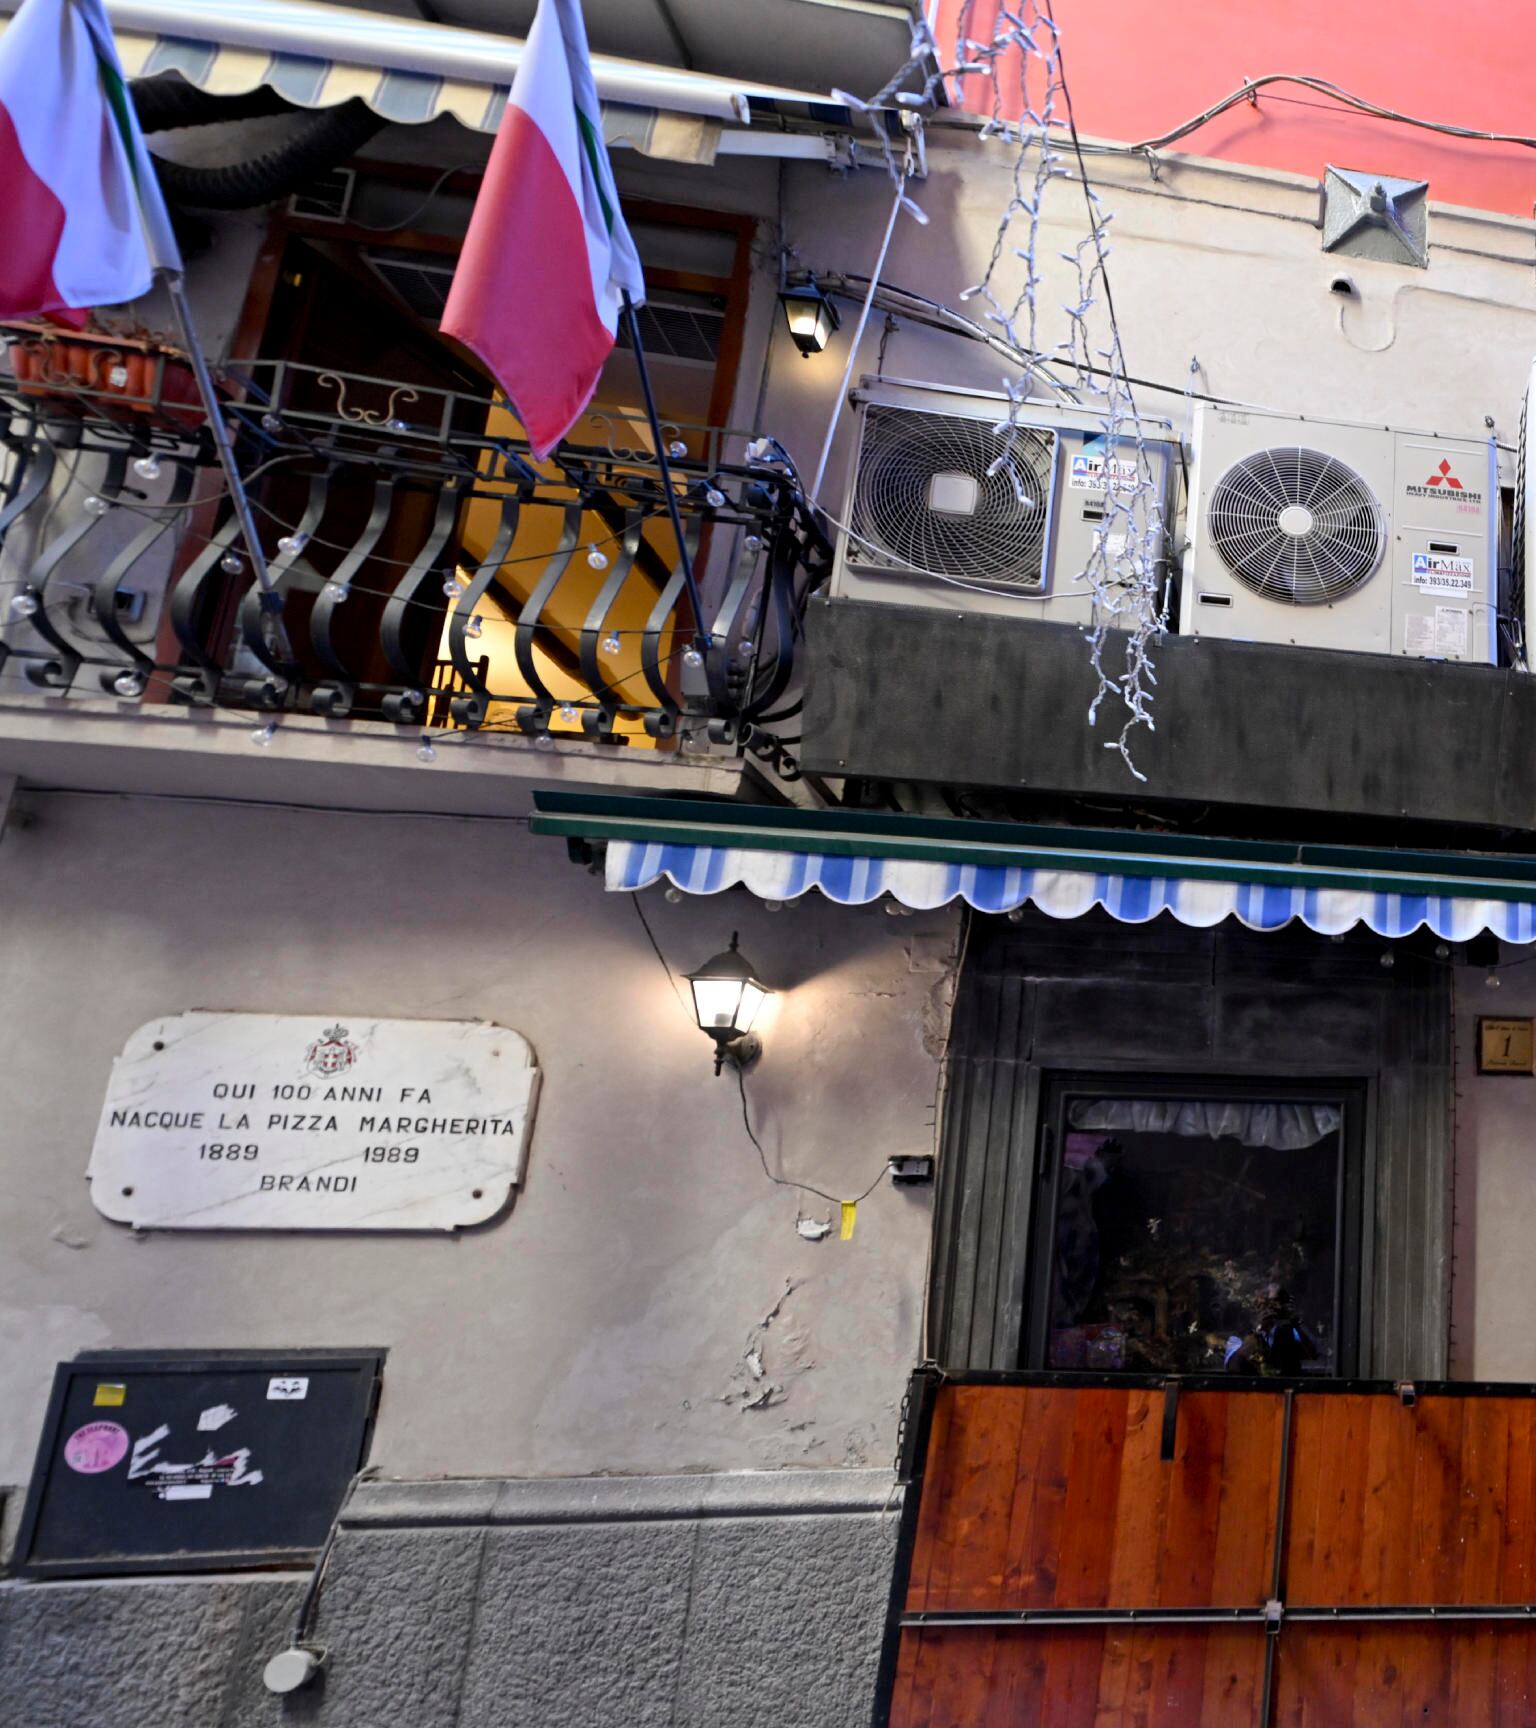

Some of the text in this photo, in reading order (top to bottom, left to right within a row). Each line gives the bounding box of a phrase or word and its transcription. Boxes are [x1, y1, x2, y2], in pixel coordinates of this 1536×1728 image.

[1074, 457, 1136, 477] Air
[1406, 485, 1481, 500] MITSUBISHI
[1414, 555, 1471, 573] AirMax
[212, 1083, 431, 1104] QUI 100 ANNI FA
[110, 1111, 514, 1135] NACQUE LA PIZZA MARGHERITA
[199, 1143, 420, 1163] 1889 1989
[259, 1174, 357, 1192] BRANDI
